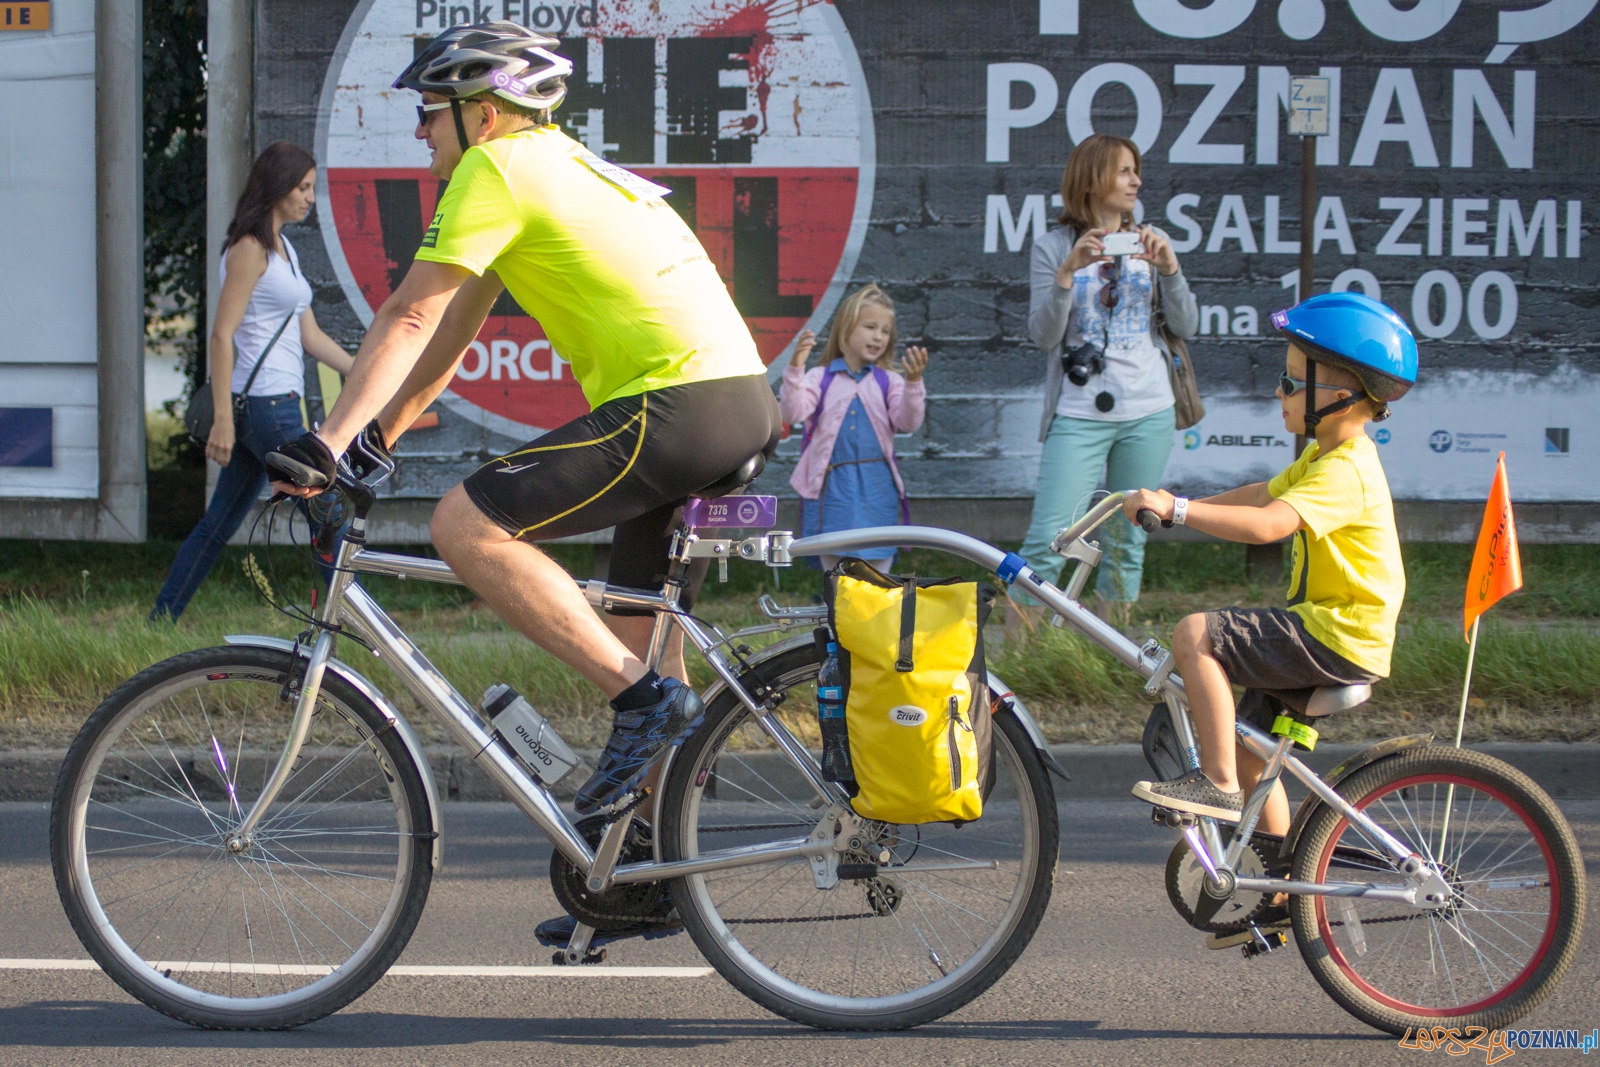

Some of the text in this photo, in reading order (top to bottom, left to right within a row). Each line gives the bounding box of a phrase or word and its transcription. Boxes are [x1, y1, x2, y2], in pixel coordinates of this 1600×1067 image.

[416, 0, 598, 33] Pink Floyd
[986, 44, 1536, 169] POZNAŃ
[1165, 193, 1358, 255] SALA
[1375, 197, 1582, 258] ZIEMI
[708, 505, 728, 516] 7376
[515, 725, 552, 766] aptonia
